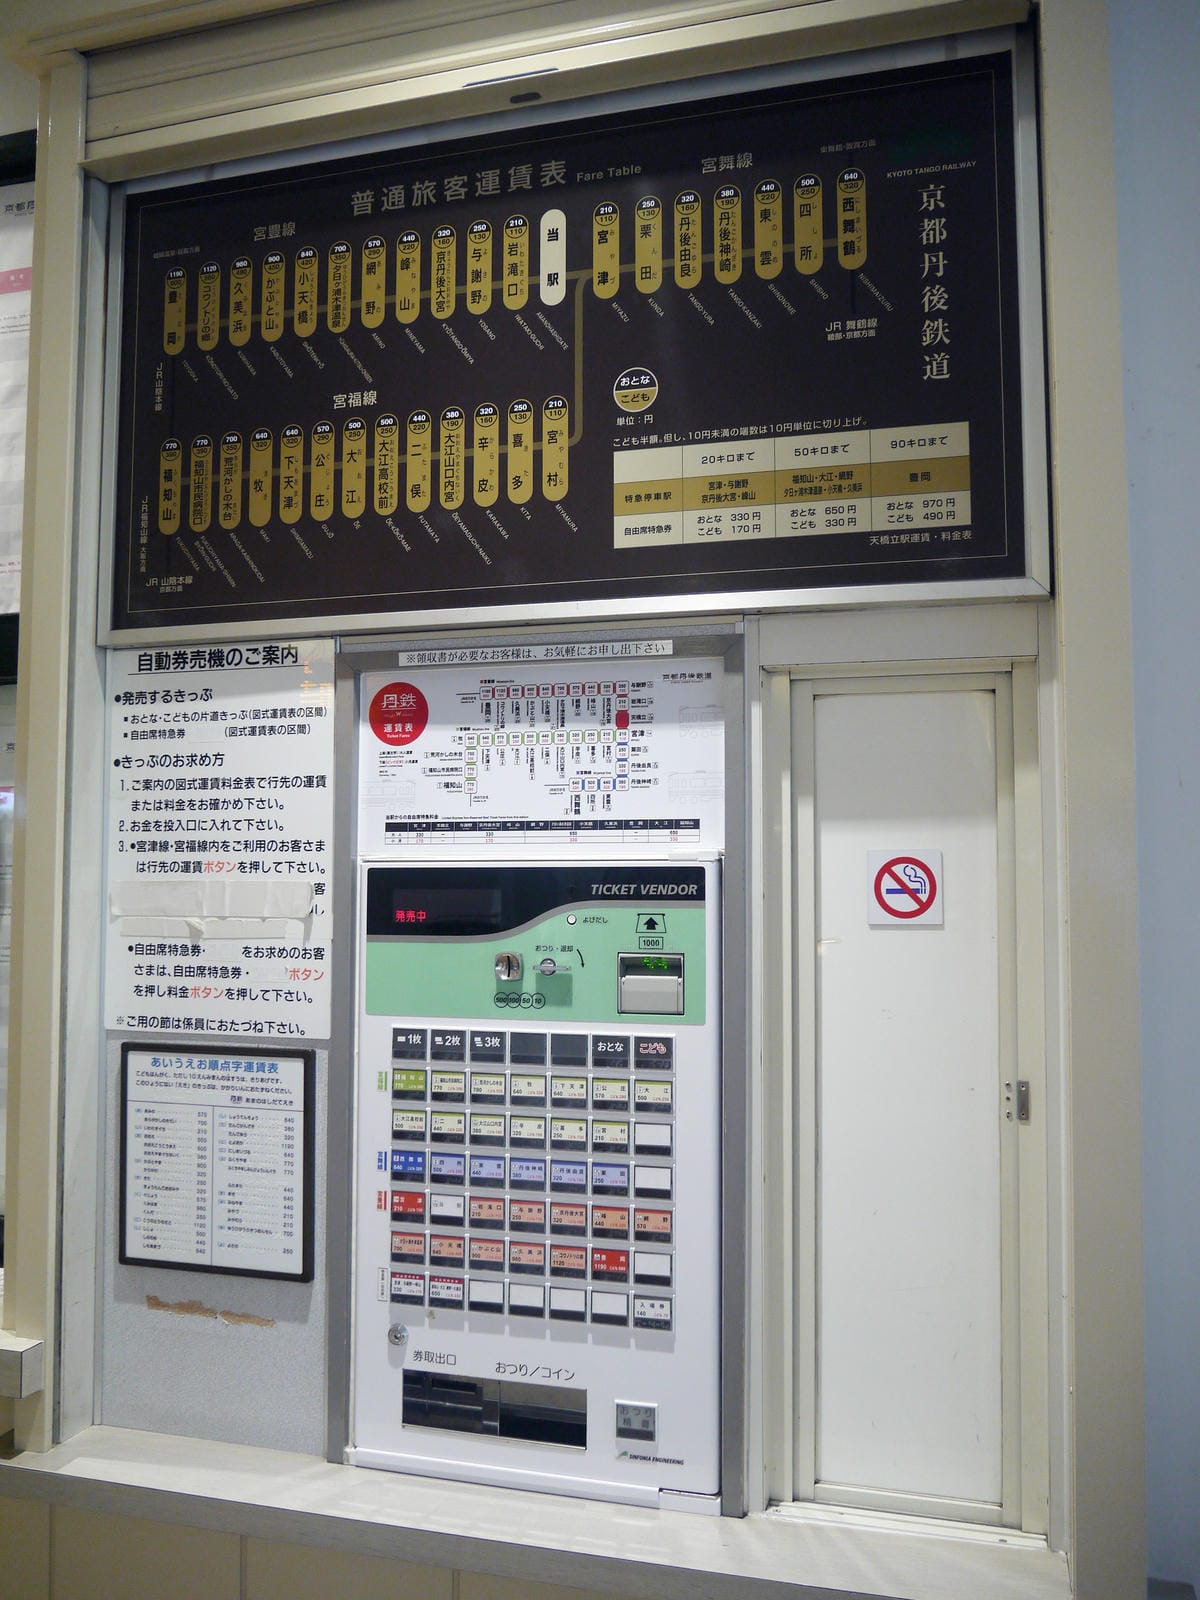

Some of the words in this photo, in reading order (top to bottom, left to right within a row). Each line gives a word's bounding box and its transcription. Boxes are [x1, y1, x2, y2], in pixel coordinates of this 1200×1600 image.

[702, 152, 753, 174] 宮舞線
[577, 168, 604, 183] Fare
[609, 164, 642, 179] Table
[844, 172, 858, 181] 640
[886, 168, 913, 180] KYOTO
[914, 165, 942, 176] TANGO
[943, 160, 977, 172] RAILWAY
[351, 160, 566, 216] 普通旅客運賃表
[761, 184, 775, 192] 440
[801, 178, 815, 187] 500
[681, 195, 695, 203] 320
[720, 189, 734, 198] 380
[600, 206, 613, 214] 210
[642, 200, 655, 209] 250
[473, 224, 487, 233] 250
[509, 219, 523, 228] 210
[842, 197, 855, 256] 西舞鶴
[254, 221, 296, 241] 宮豊線
[438, 229, 451, 239] 320
[759, 208, 772, 266] 東雲
[799, 203, 812, 261] 四所
[368, 240, 381, 248] 570
[402, 234, 415, 243] 440
[719, 211, 731, 273] 丹後神崎
[334, 245, 347, 253] 700
[640, 223, 652, 281] 栗田
[679, 217, 691, 278] 丹後由良
[546, 227, 559, 287] 当駅
[597, 230, 608, 286] 宮津
[471, 248, 482, 304] 与謝野
[507, 242, 518, 297] 岩滝口
[365, 261, 376, 315] 網野
[400, 257, 410, 311] 峰山
[436, 250, 446, 313] 京丹後大宮
[917, 184, 951, 380] 京都丹後鉄道
[265, 278, 276, 330] かぶと山
[298, 272, 309, 324] 小天橋
[232, 282, 243, 334] 久美浜
[826, 321, 842, 332] JR
[620, 375, 650, 387] おとな
[333, 390, 378, 410] 宮福線
[548, 400, 562, 408] 210
[621, 393, 650, 403] こども
[446, 411, 459, 419] 380
[480, 407, 493, 416] 320
[514, 404, 527, 413] 250
[380, 418, 393, 427] 500
[413, 415, 426, 423] 440
[616, 414, 653, 426] 単位：円
[317, 426, 330, 434] 570
[348, 422, 361, 430] 500
[255, 433, 267, 441] 640
[285, 430, 299, 438] 640
[197, 440, 208, 448] 770
[226, 437, 238, 445] 700
[478, 436, 489, 493] 辛皮
[512, 432, 524, 491] 喜多
[547, 430, 559, 488] 宮村
[378, 440, 389, 509] 大江高校前
[410, 444, 422, 499] 二俣
[444, 433, 455, 503] 大江山口内宮
[283, 455, 294, 510] 下天津
[314, 453, 325, 508] 公庄
[345, 449, 357, 504] 大江
[223, 457, 233, 521] 荒河かしの木台
[253, 478, 263, 493] 牧
[625, 491, 672, 503] 特急停車駅
[887, 501, 913, 511] おとな
[520, 506, 532, 521] KITA
[790, 508, 816, 518] おとな
[888, 514, 913, 524] こども
[697, 515, 722, 525] おとな
[791, 520, 816, 530] こども
[624, 525, 672, 536] 自由席特急券
[698, 527, 722, 536] こども
[869, 530, 971, 547] 天橋立駅運賃・料金表
[138, 645, 299, 673] 自動券売機のご案内
[122, 688, 213, 706] 発売するきっぷ
[384, 723, 413, 732] 運賃表
[130, 729, 186, 741] 自由席特急券
[121, 752, 225, 768] きっぷのお求め方
[131, 798, 285, 811] または料金をお確かめ下さい。
[136, 860, 326, 875] は行先の運賃ボタンを押して下さい。
[313, 882, 325, 896] 客
[591, 884, 637, 895] TICKET
[641, 884, 698, 896] VENDOR
[395, 909, 426, 922] 発売中
[582, 916, 608, 924] よびだし
[643, 939, 660, 947] 1000
[242, 946, 325, 960] をお求めのお客
[289, 968, 325, 981] ボタン
[133, 984, 313, 1004] を押し料金ボタンを押して下さい。
[407, 1034, 422, 1045] 1枚
[445, 1036, 460, 1046] 2枚
[485, 1037, 500, 1048] 3枚
[597, 1042, 624, 1054] おとな
[639, 1043, 667, 1055] こども
[151, 1057, 279, 1075] あいうえお順点字運賃表
[413, 1350, 456, 1365] 券取出口
